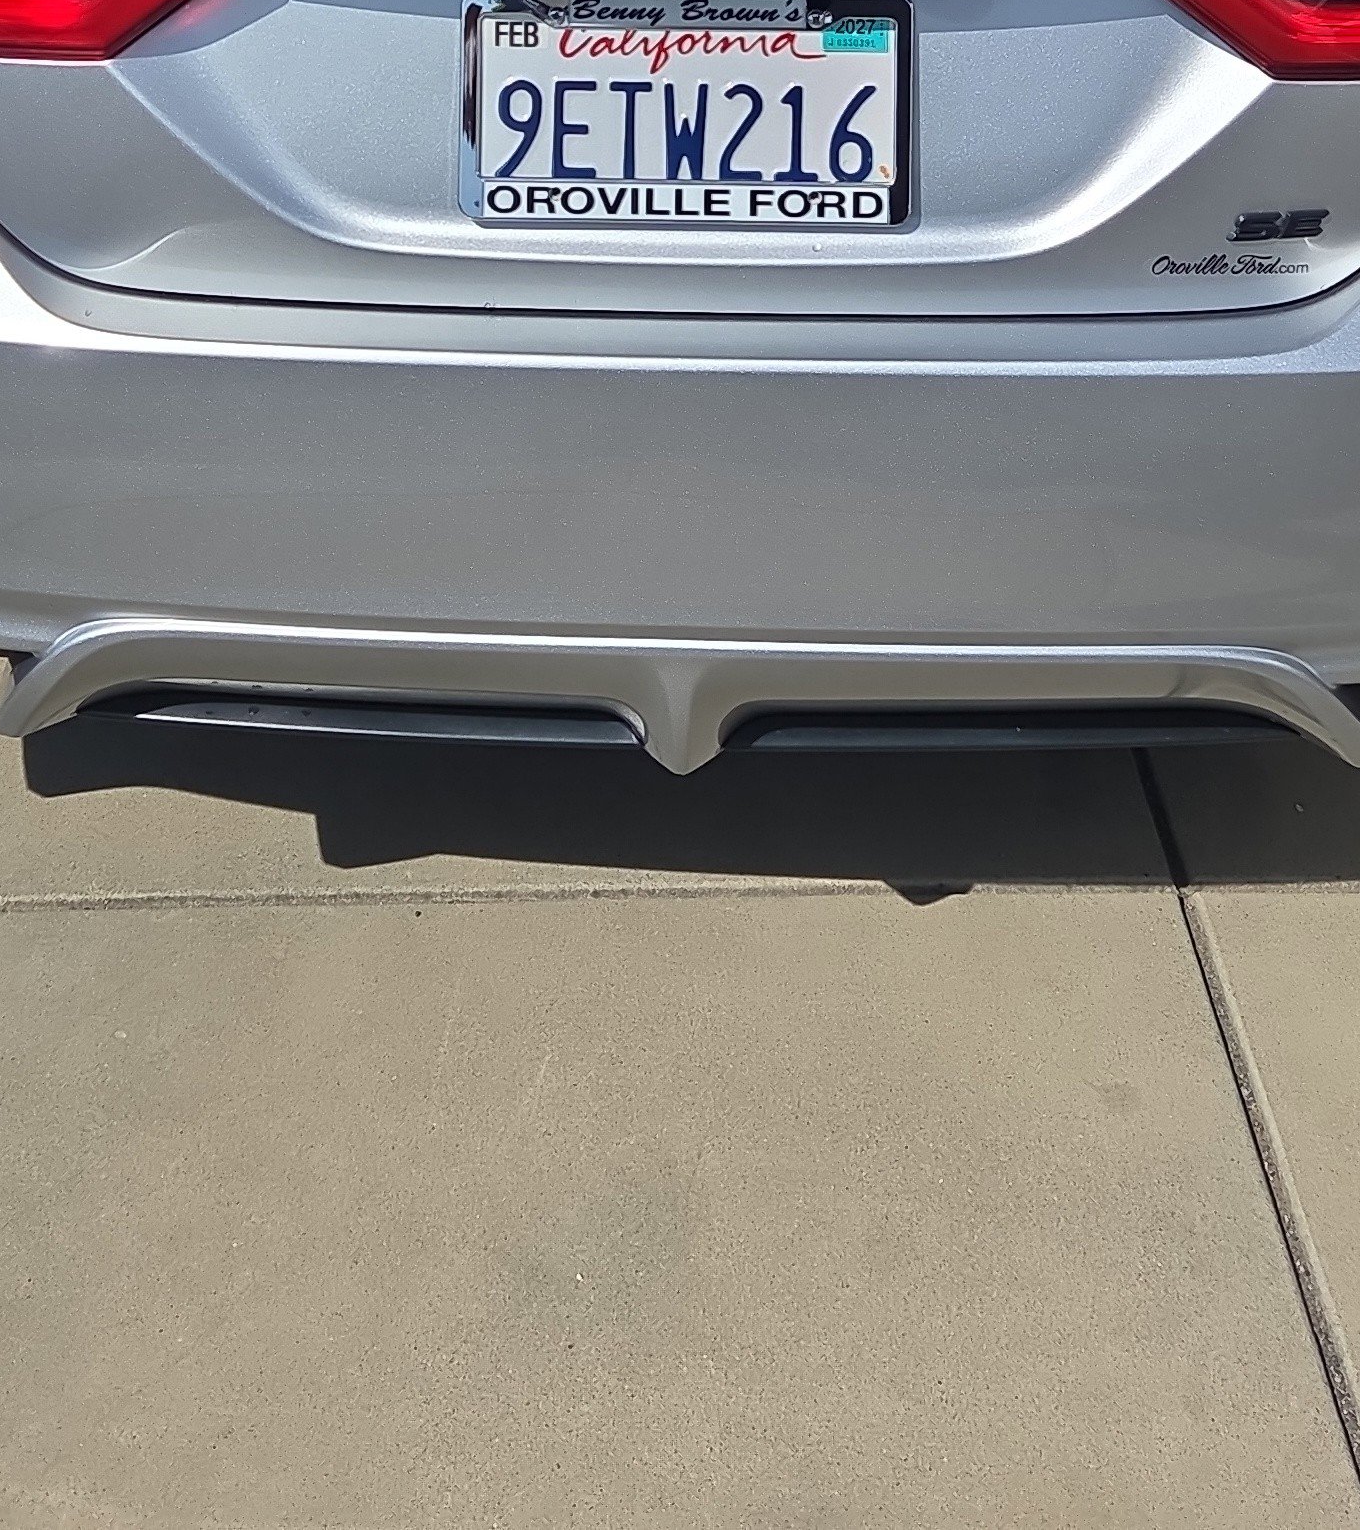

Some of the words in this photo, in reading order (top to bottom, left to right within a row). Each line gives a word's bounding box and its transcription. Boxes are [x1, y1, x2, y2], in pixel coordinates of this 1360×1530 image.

[495, 21, 539, 49] FEB
[835, 18, 876, 35] 2027
[559, 27, 827, 75] California
[495, 79, 878, 183] 9ETW216
[487, 186, 731, 217] OROVILLE
[750, 189, 884, 219] FORD
[1226, 208, 1330, 242] SE
[1151, 254, 1230, 275] Oroville
